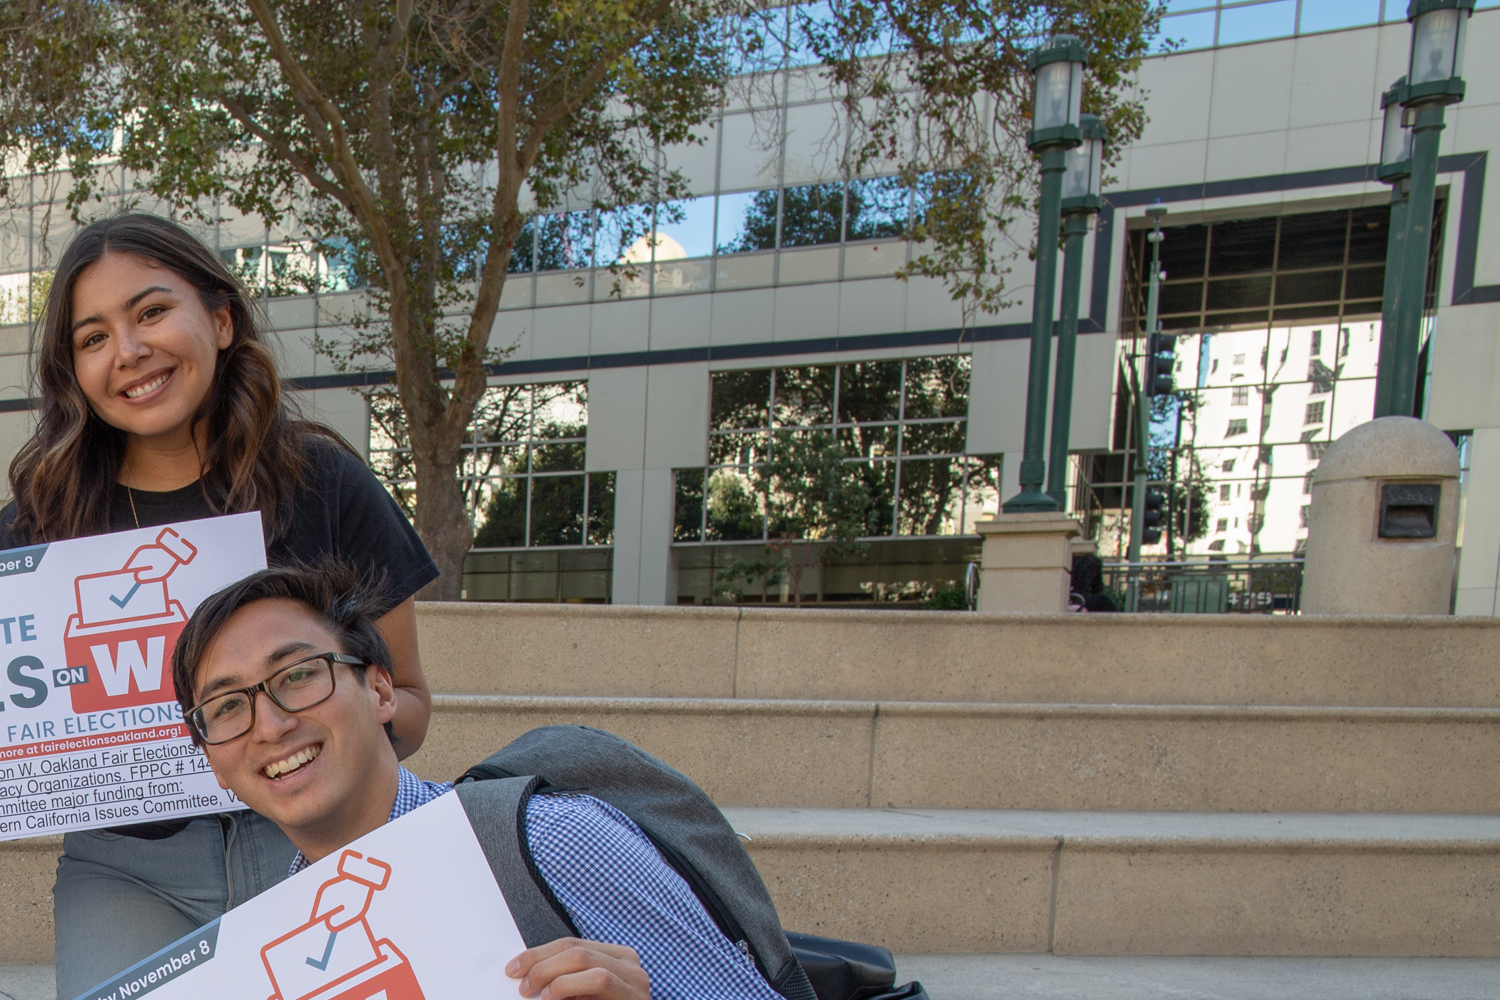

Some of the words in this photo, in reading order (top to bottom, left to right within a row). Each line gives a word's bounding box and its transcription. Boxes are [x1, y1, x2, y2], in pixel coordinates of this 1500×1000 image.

[23, 554, 34, 568] 8
[55, 666, 85, 685] ON
[88, 634, 166, 697] W
[6, 719, 56, 743] FAIR
[62, 701, 186, 735] ELECTIONS
[25, 744, 39, 755] at
[39, 724, 182, 753] fairelectionsoakland.org!
[50, 791, 91, 812] major
[91, 784, 145, 806] funding
[146, 780, 184, 796] from:
[118, 947, 196, 1000] November
[197, 938, 211, 955] 8
